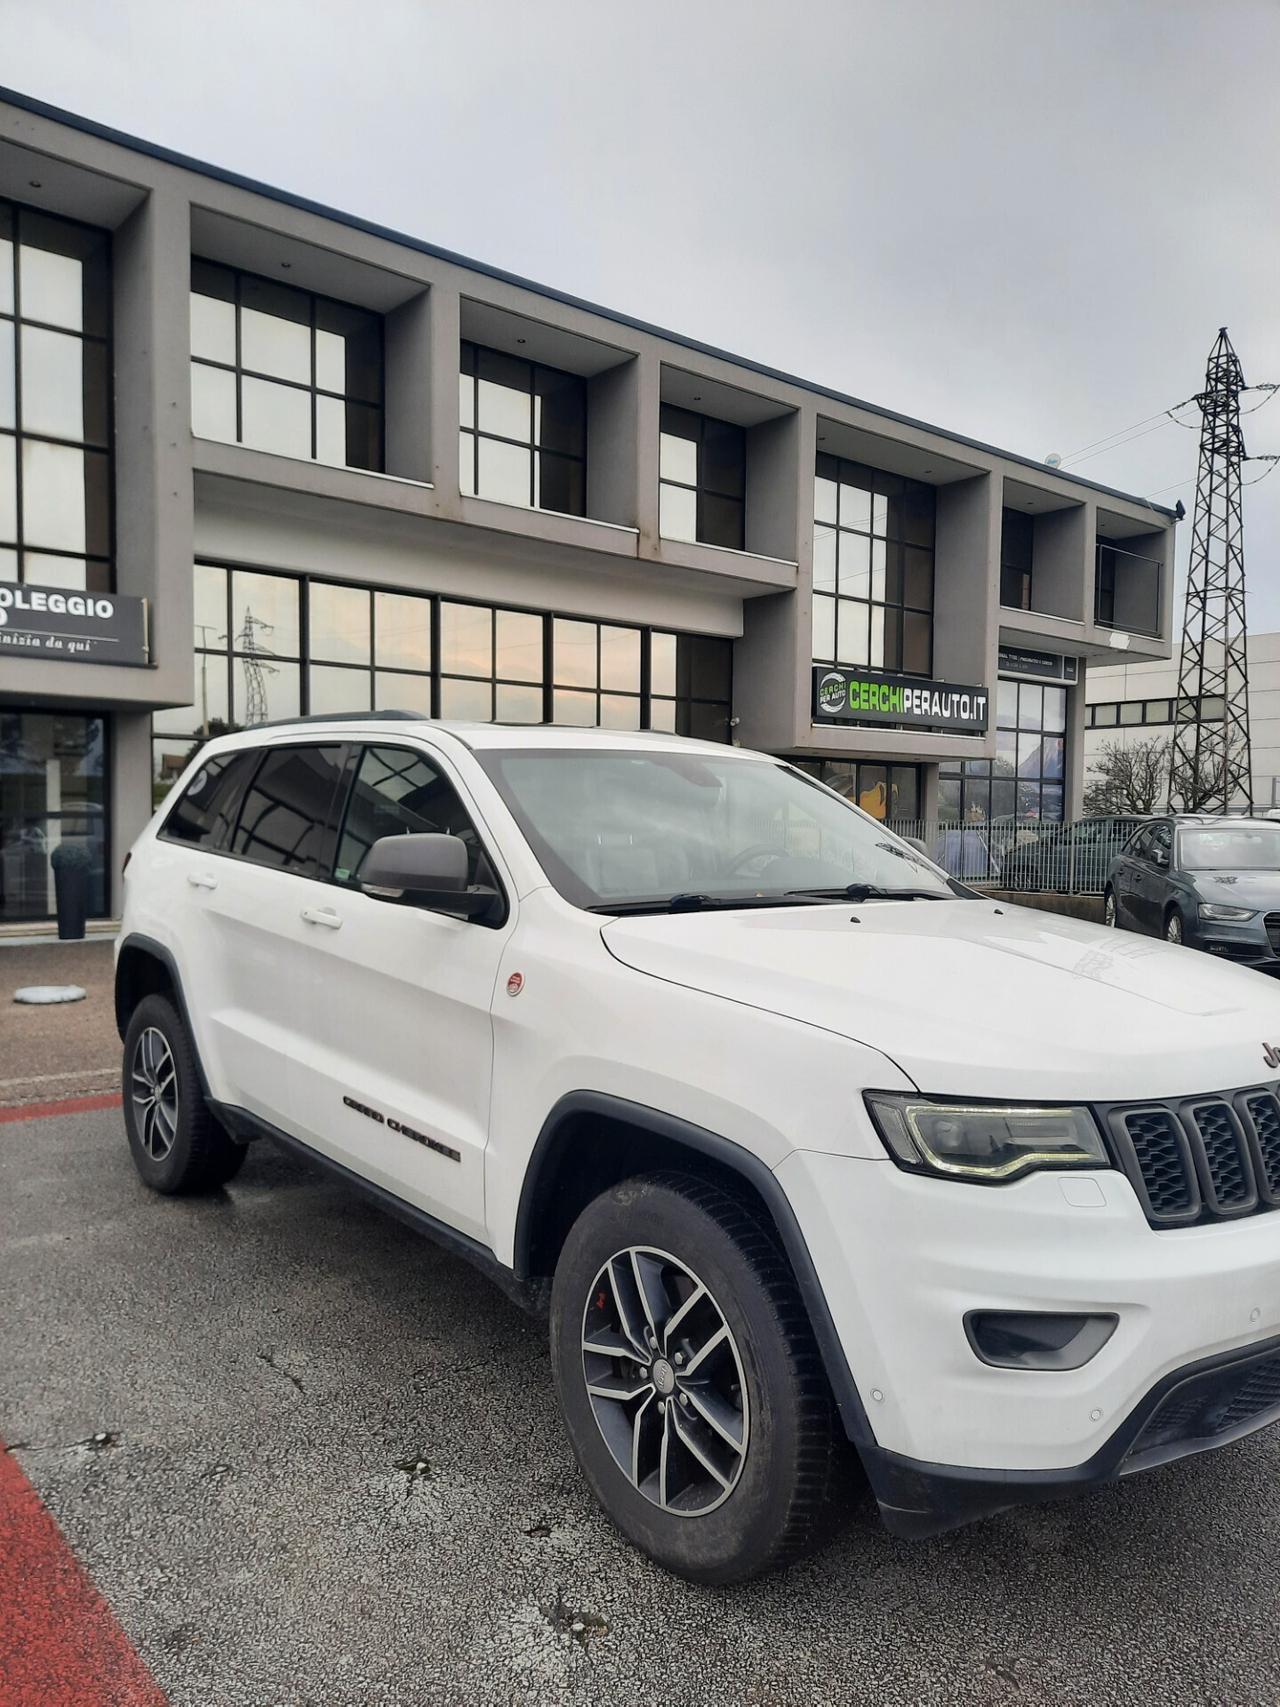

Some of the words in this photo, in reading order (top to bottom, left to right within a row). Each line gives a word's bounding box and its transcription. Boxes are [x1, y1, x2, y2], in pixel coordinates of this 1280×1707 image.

[820, 682, 847, 696] CERCHI
[831, 689, 846, 700] AUTO
[849, 681, 986, 720] CERCHIPERAUTO.IT
